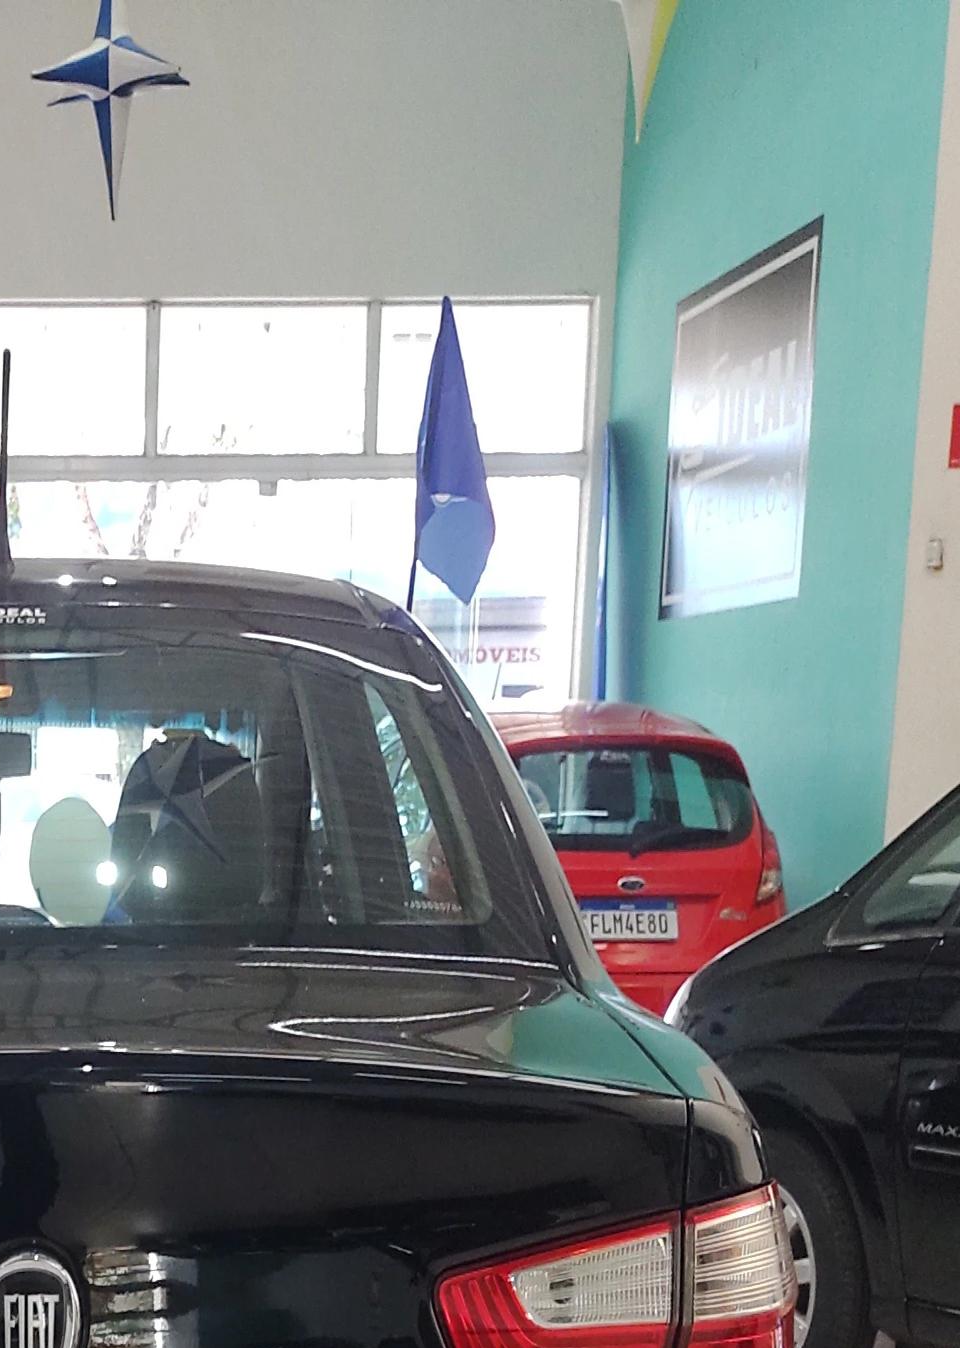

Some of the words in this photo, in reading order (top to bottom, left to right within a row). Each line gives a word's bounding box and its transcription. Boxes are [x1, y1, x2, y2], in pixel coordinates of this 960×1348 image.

[444, 646, 541, 664] MOVEIS
[590, 912, 669, 935] FLM4E80
[917, 1122, 960, 1138] MAX
